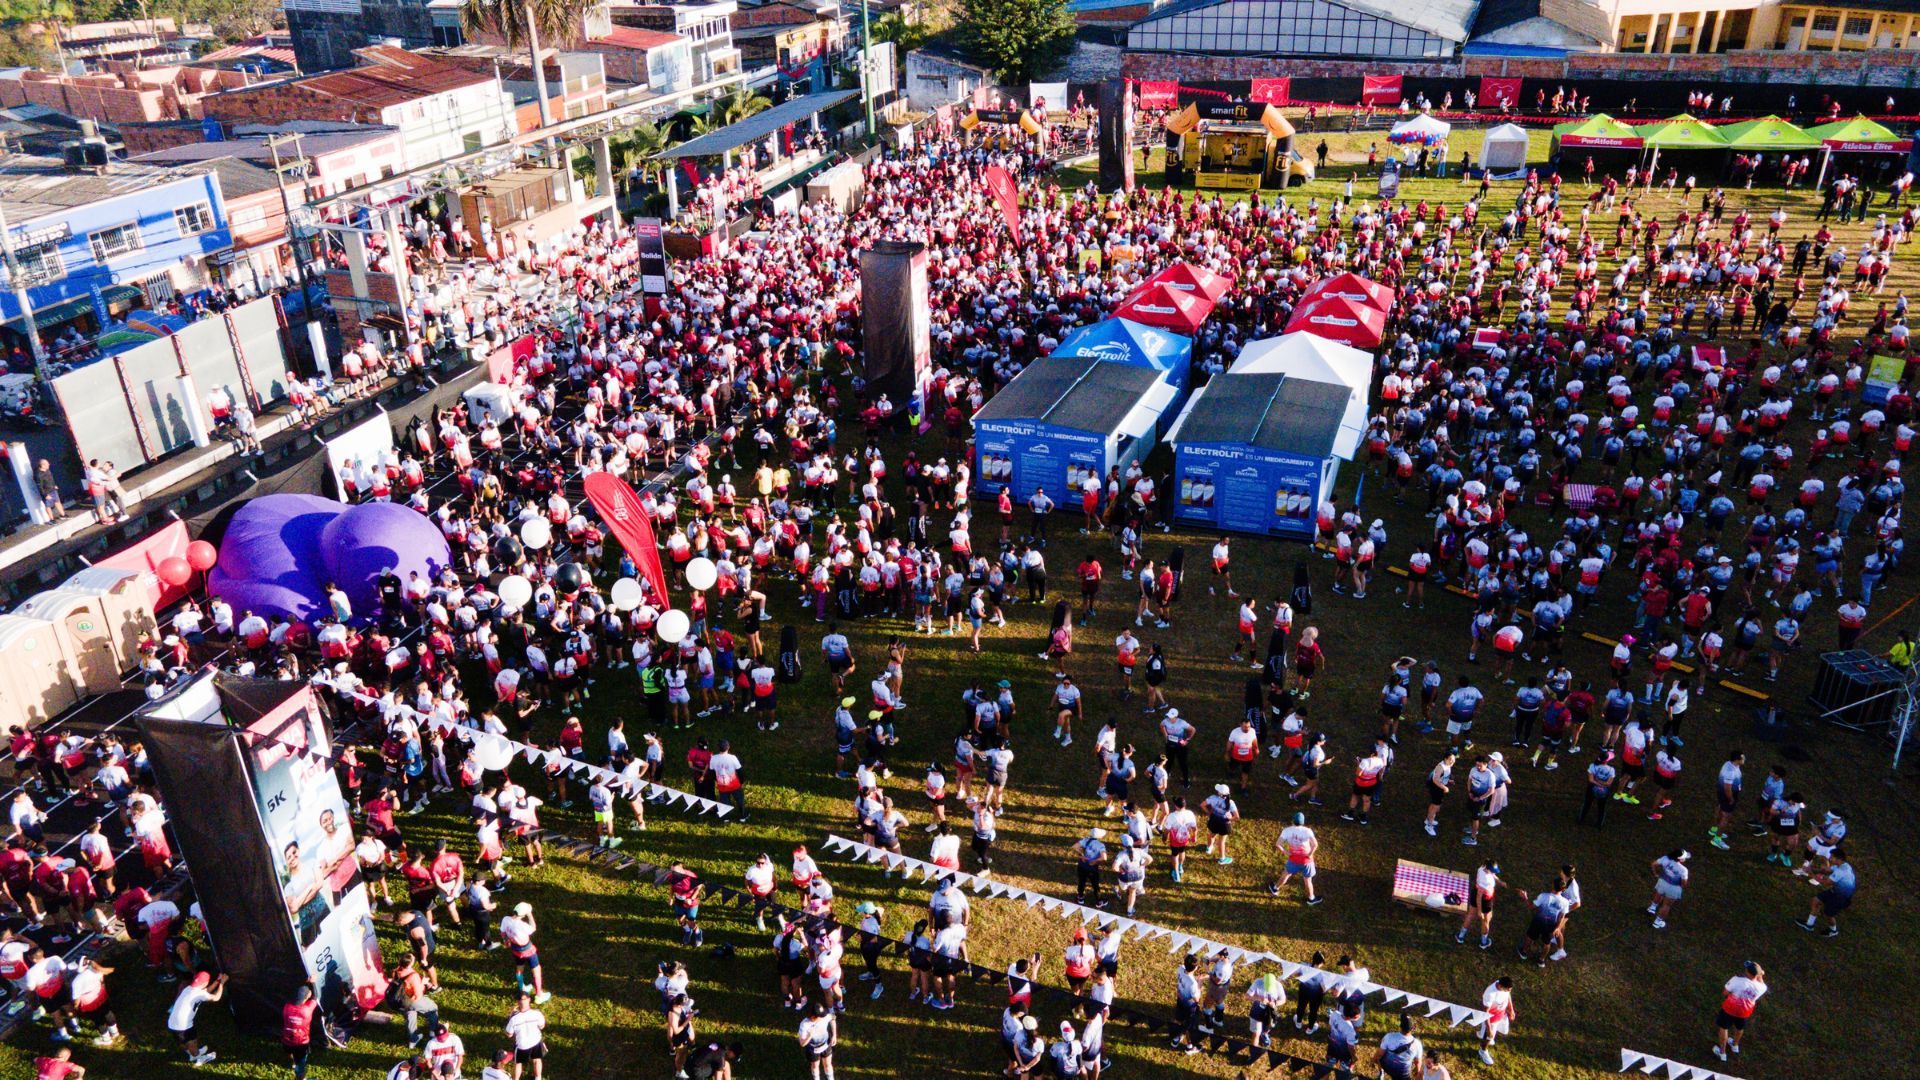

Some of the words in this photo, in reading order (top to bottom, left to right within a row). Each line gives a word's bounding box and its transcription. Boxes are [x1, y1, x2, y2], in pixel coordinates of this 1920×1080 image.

[1581, 137, 1622, 145] ParAtletas
[1841, 142, 1872, 150] Atletas
[1054, 433, 1099, 443] MEDICAMENTO
[1264, 456, 1315, 467] MEDICAMENTO
[267, 790, 287, 812] 5K
